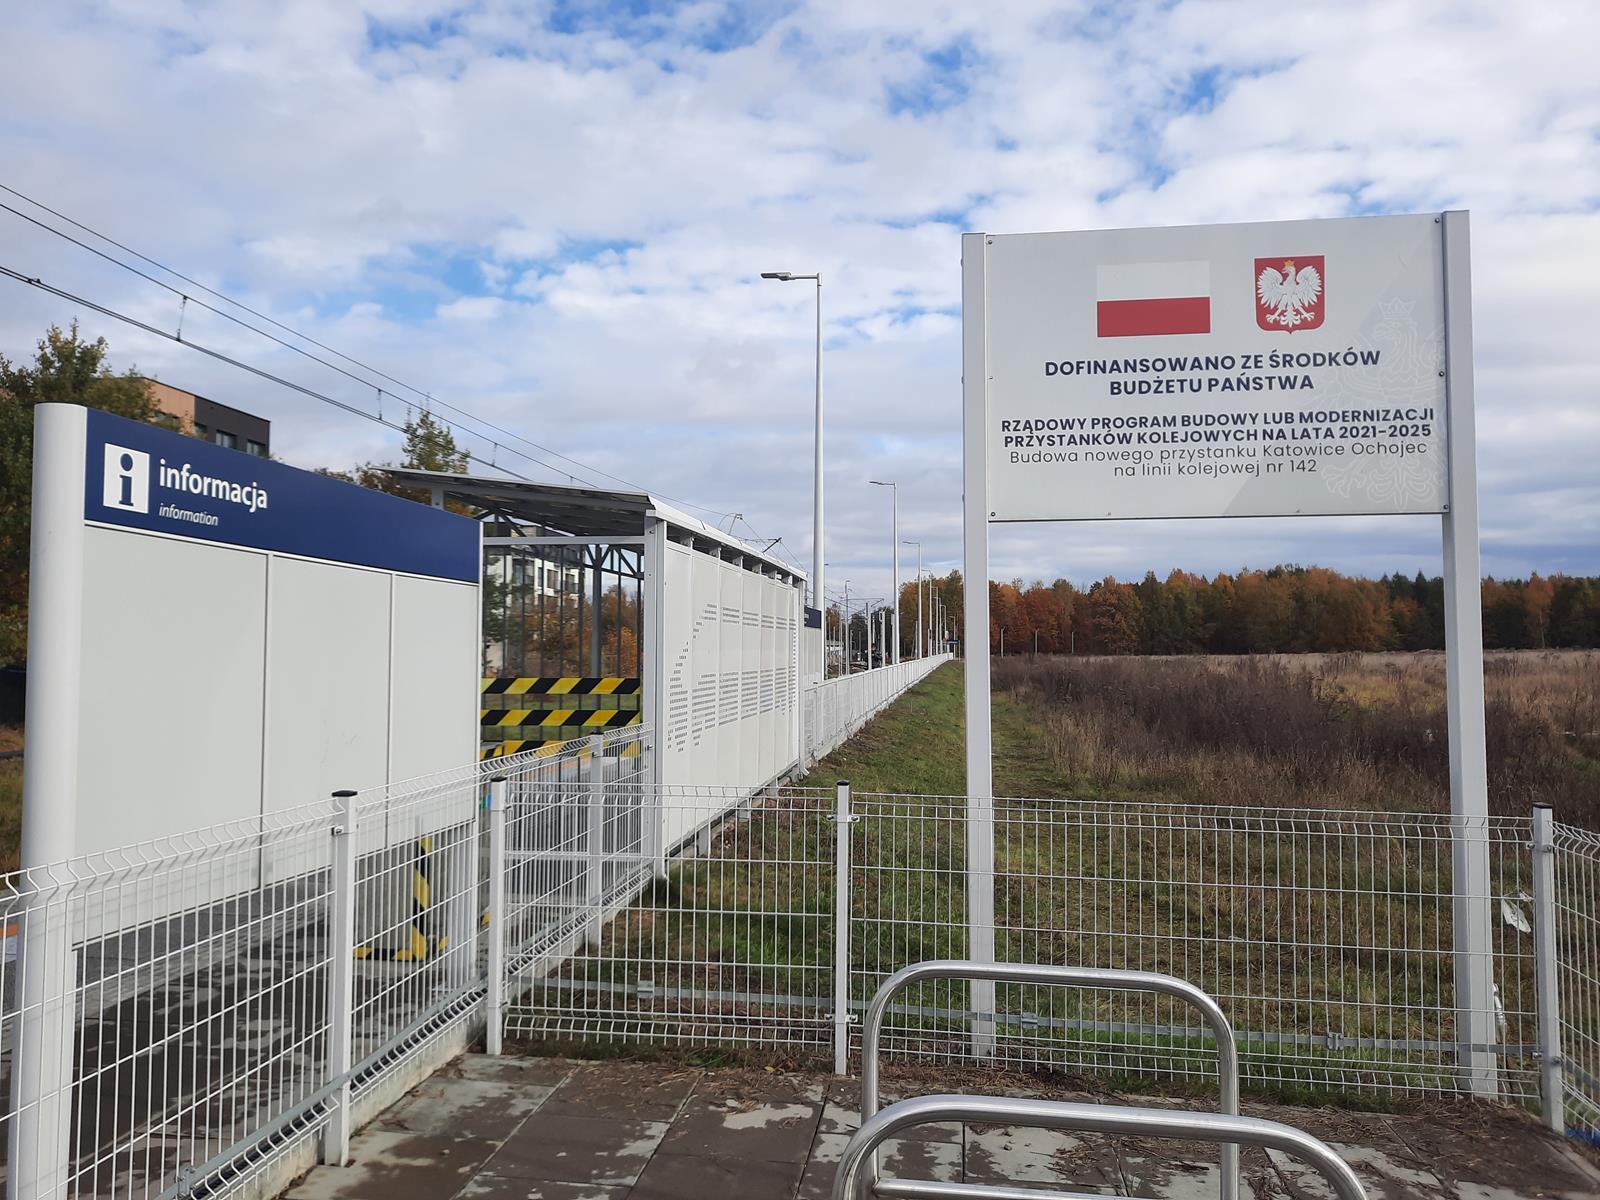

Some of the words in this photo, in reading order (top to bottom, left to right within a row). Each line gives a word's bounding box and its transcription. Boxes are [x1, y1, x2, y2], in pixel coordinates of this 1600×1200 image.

[1045, 355, 1236, 376] DOFINANSOWANO
[1240, 354, 1264, 370] ZE
[1269, 347, 1381, 369] ŚRODKÓW
[1110, 376, 1202, 395] BUDŻETU
[1207, 372, 1314, 392] PAŃSTWA
[1001, 418, 1087, 434] RZĄDOWY
[1091, 415, 1177, 430] PROGRAM
[1181, 412, 1259, 427] BUDOWY
[1263, 412, 1295, 425] LUB
[1299, 408, 1434, 424] MODERNIZACJI
[1004, 430, 1133, 448] PRZYSTANKÓW
[1137, 429, 1258, 444] KOLEJOWYCH
[1262, 428, 1287, 441] NA
[1291, 427, 1335, 440] LATA
[1010, 450, 1078, 464] Budowa
[1084, 449, 1154, 464] nowego
[1160, 445, 1256, 463] przystanku
[1263, 442, 1345, 457] Katowice
[1351, 441, 1427, 457] Ochojec
[1114, 465, 1136, 477] na
[1142, 462, 1171, 476] linii
[1177, 461, 1260, 478] kolejowej
[1266, 461, 1283, 473] nr
[1290, 459, 1317, 473] 142
[159, 459, 268, 513] informacja
[158, 503, 219, 527] information
